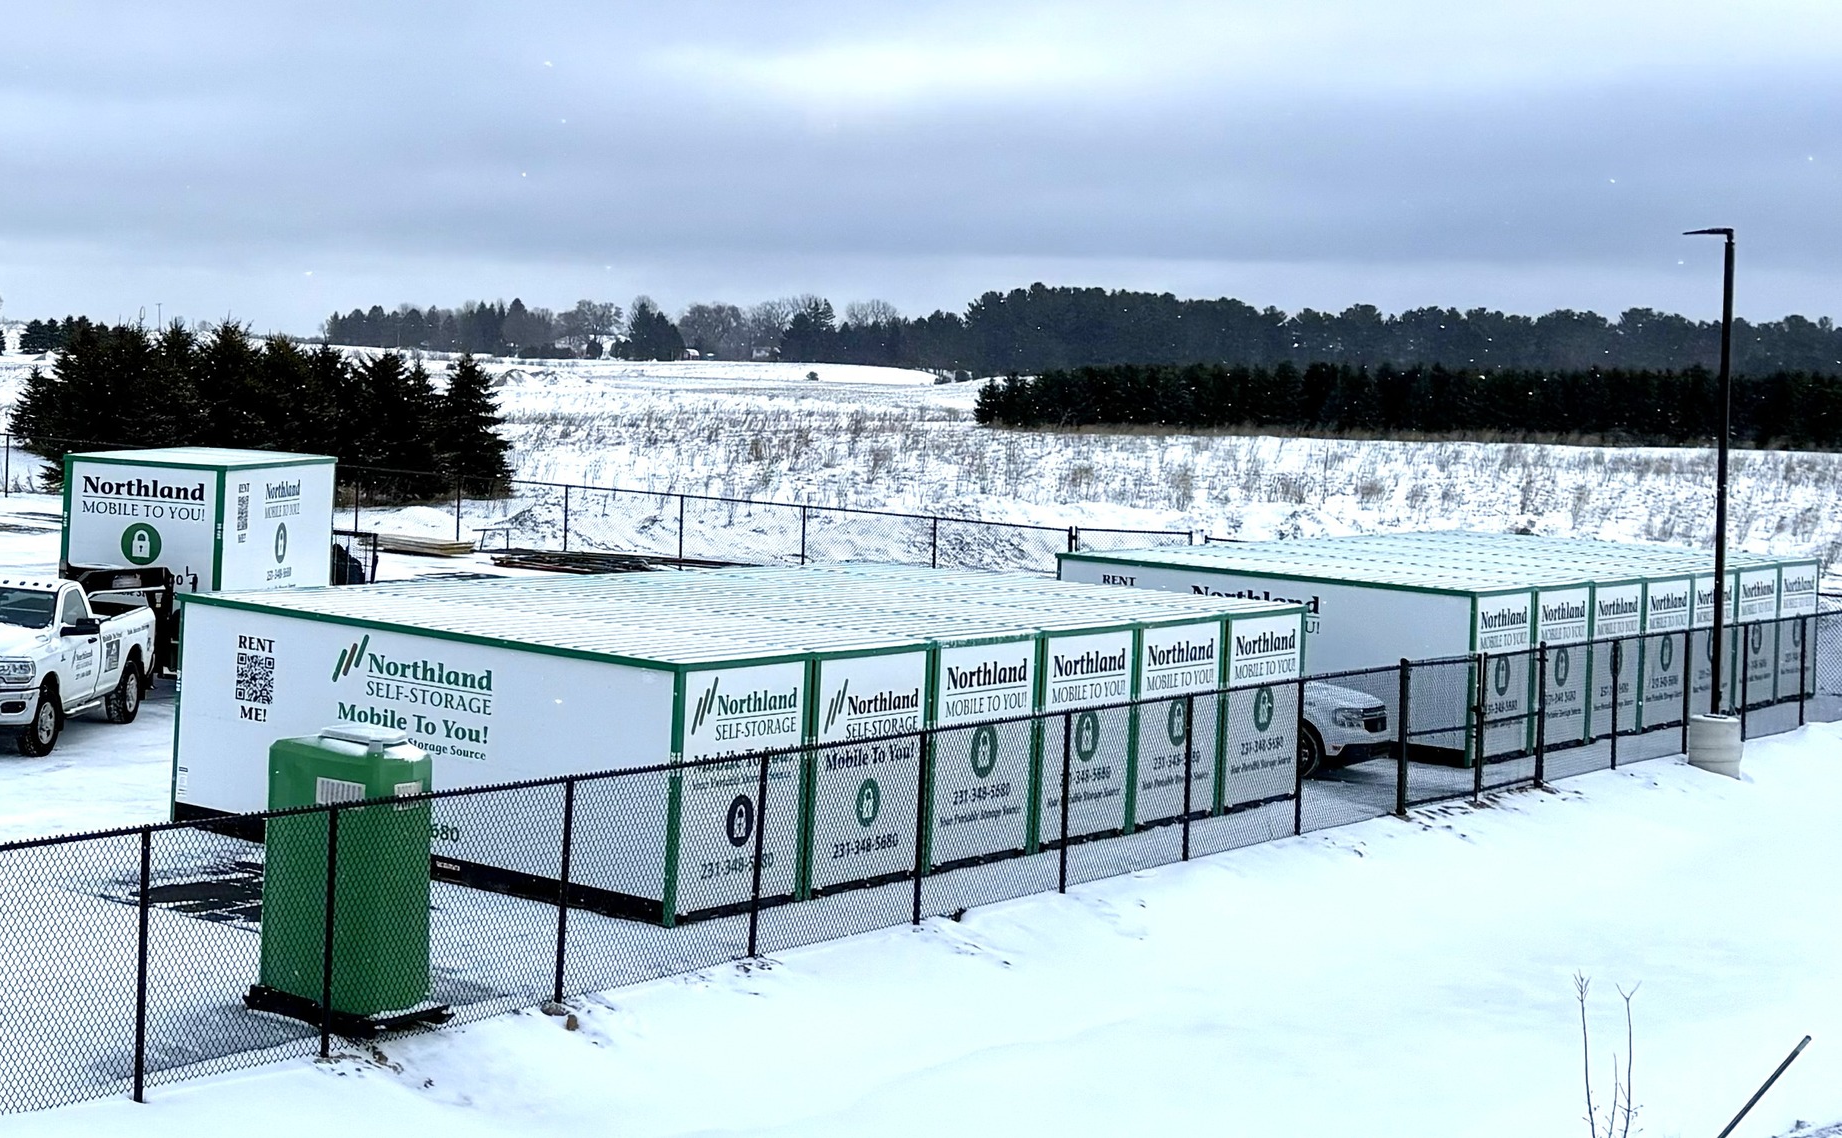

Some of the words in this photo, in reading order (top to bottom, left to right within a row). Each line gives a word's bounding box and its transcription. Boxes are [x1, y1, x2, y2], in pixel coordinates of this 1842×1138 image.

[83, 476, 204, 501] Northland
[265, 479, 301, 500] Northland
[82, 501, 138, 517] MOBILE
[144, 504, 164, 518] TO
[168, 507, 205, 521] YOU!
[1102, 574, 1136, 586] RENT
[1541, 600, 1585, 622] Northland
[1598, 596, 1638, 617] Northland
[1650, 591, 1687, 612] Northland
[1481, 606, 1527, 629] Northland
[238, 635, 275, 653] RENT
[1148, 638, 1214, 666] Northland
[1236, 629, 1296, 656] Northland
[368, 652, 493, 691] Northland
[947, 658, 1027, 690] Northland
[1053, 648, 1125, 678] Northland
[1235, 661, 1263, 680] MOBILE
[1265, 660, 1276, 676] TO
[1147, 672, 1178, 691] MOBILE
[1180, 671, 1192, 687] TO
[1194, 668, 1214, 685] YOU!
[366, 681, 492, 715] SELF-STORAGE
[717, 687, 797, 716] Northland
[848, 688, 918, 716] Northland
[1052, 685, 1087, 704] MOBILE
[1089, 683, 1102, 699] TO
[1104, 680, 1125, 697] YOU!
[240, 706, 267, 723] ME!
[945, 697, 984, 718] MOBILE
[987, 695, 1001, 711] TO
[1003, 692, 1027, 710] YOU!
[338, 702, 408, 730] Mobile
[412, 713, 436, 735] To
[442, 718, 489, 744] You!
[715, 717, 797, 741] SELF-STORAGE
[846, 715, 918, 740] SELF-STORAGE
[450, 744, 487, 761] Source
[826, 750, 869, 771] Mobile
[872, 747, 885, 764] To
[889, 742, 915, 761] You!
[833, 833, 899, 859] 231-348-5680
